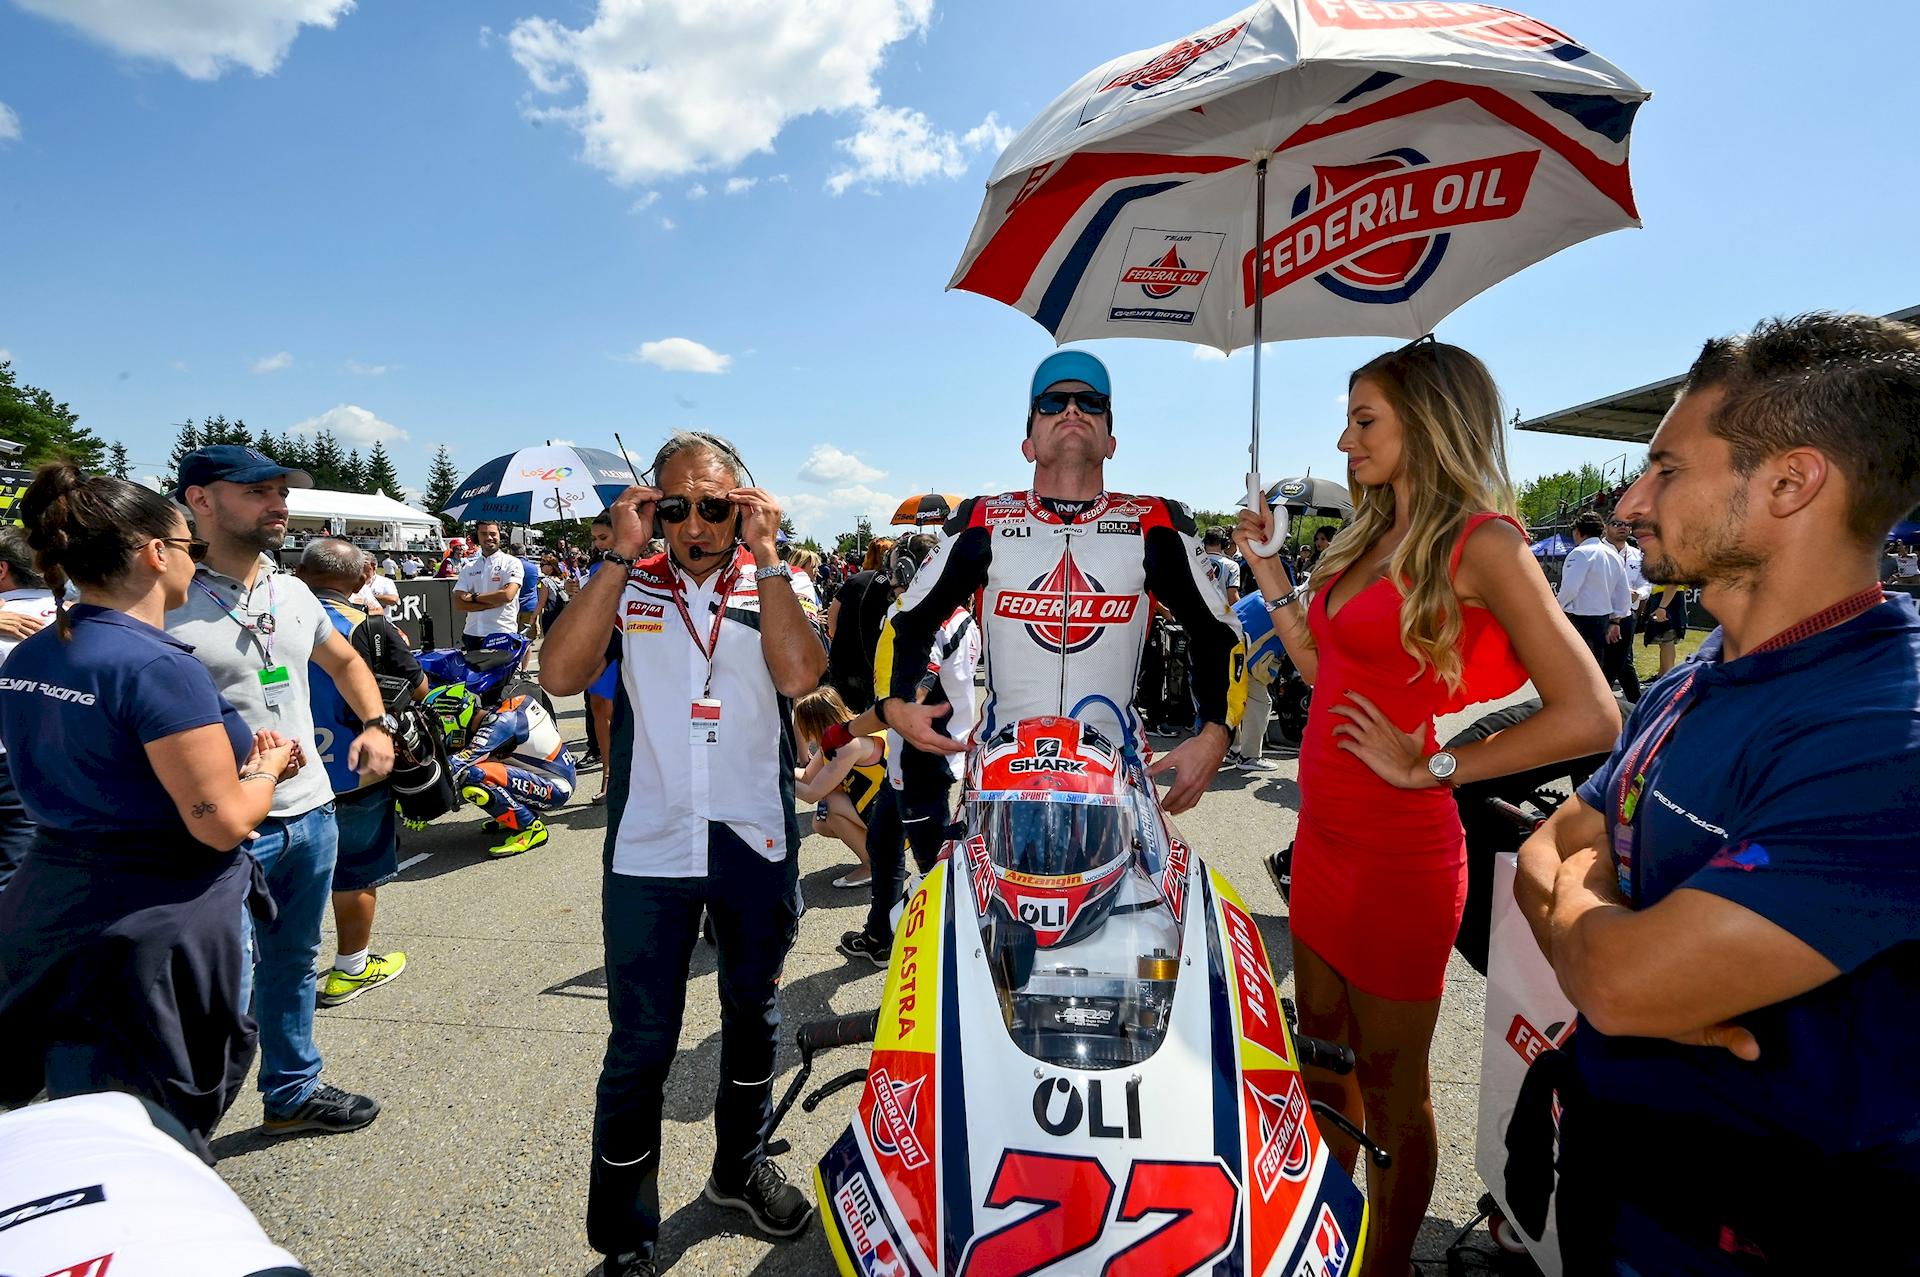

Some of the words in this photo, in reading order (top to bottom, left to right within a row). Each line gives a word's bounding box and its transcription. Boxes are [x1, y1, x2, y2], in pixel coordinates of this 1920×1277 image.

[1253, 183, 1419, 278] FEDERAL
[1433, 168, 1506, 214] OIL
[1126, 269, 1179, 282] FEDERAL
[1180, 272, 1201, 283] OIL
[992, 507, 1024, 515] ASPIRA
[1037, 510, 1051, 521] OIL
[1001, 526, 1031, 538] OLI
[1053, 526, 1083, 535] BERING
[1099, 522, 1129, 530] BOLD
[629, 602, 662, 615] ASPIRA
[999, 595, 1094, 619] FEDERAL
[1099, 600, 1131, 619] OIL
[627, 622, 662, 632] ntangin
[38, 682, 97, 706] RACING
[1010, 759, 1087, 775] SHARK
[1005, 871, 1082, 887] Antangin
[905, 889, 928, 938] GS
[1019, 903, 1065, 927] OLI
[1229, 910, 1269, 1028] ASPIRA
[898, 946, 918, 1040] ASTRA
[875, 1075, 906, 1137] FEDERAL
[900, 1135, 919, 1163] OIL
[1033, 1077, 1142, 1139] OLI
[1261, 1113, 1296, 1183] FEDERAL
[1290, 1091, 1303, 1120] OIL
[849, 1176, 877, 1230] uma
[960, 1147, 1239, 1277] 22
[839, 1190, 873, 1256] racing
